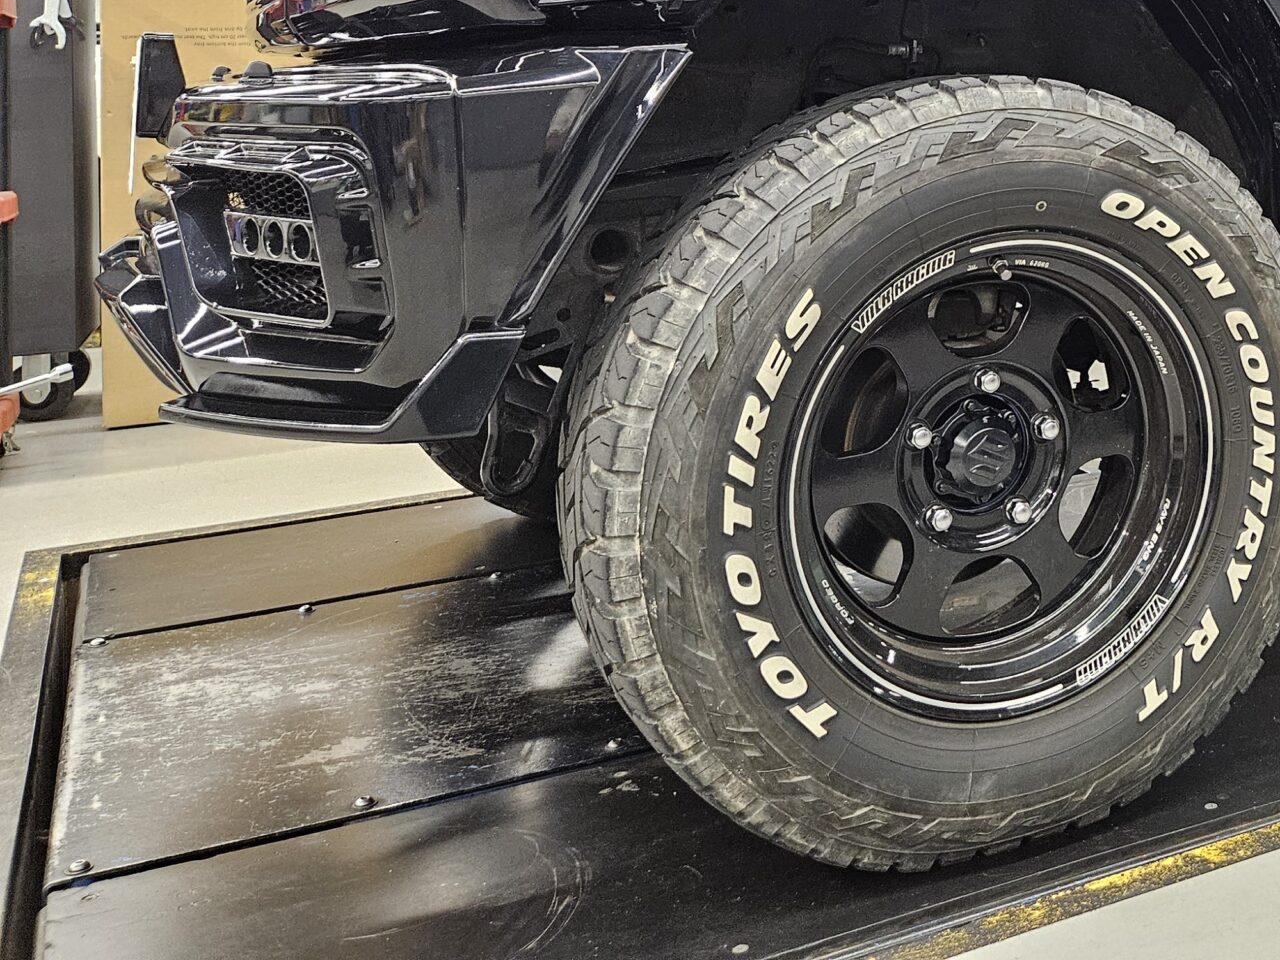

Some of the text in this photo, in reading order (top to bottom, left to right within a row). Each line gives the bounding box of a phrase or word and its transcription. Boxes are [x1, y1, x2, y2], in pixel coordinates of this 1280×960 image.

[1100, 191, 1236, 300] OPEN
[1126, 310, 1168, 374] MADE IN JAPAN
[1224, 308, 1276, 604] COUNTRY
[723, 288, 838, 739] TOYO TIRES
[821, 579, 855, 625] FORGED
[1137, 606, 1220, 723] R/T
